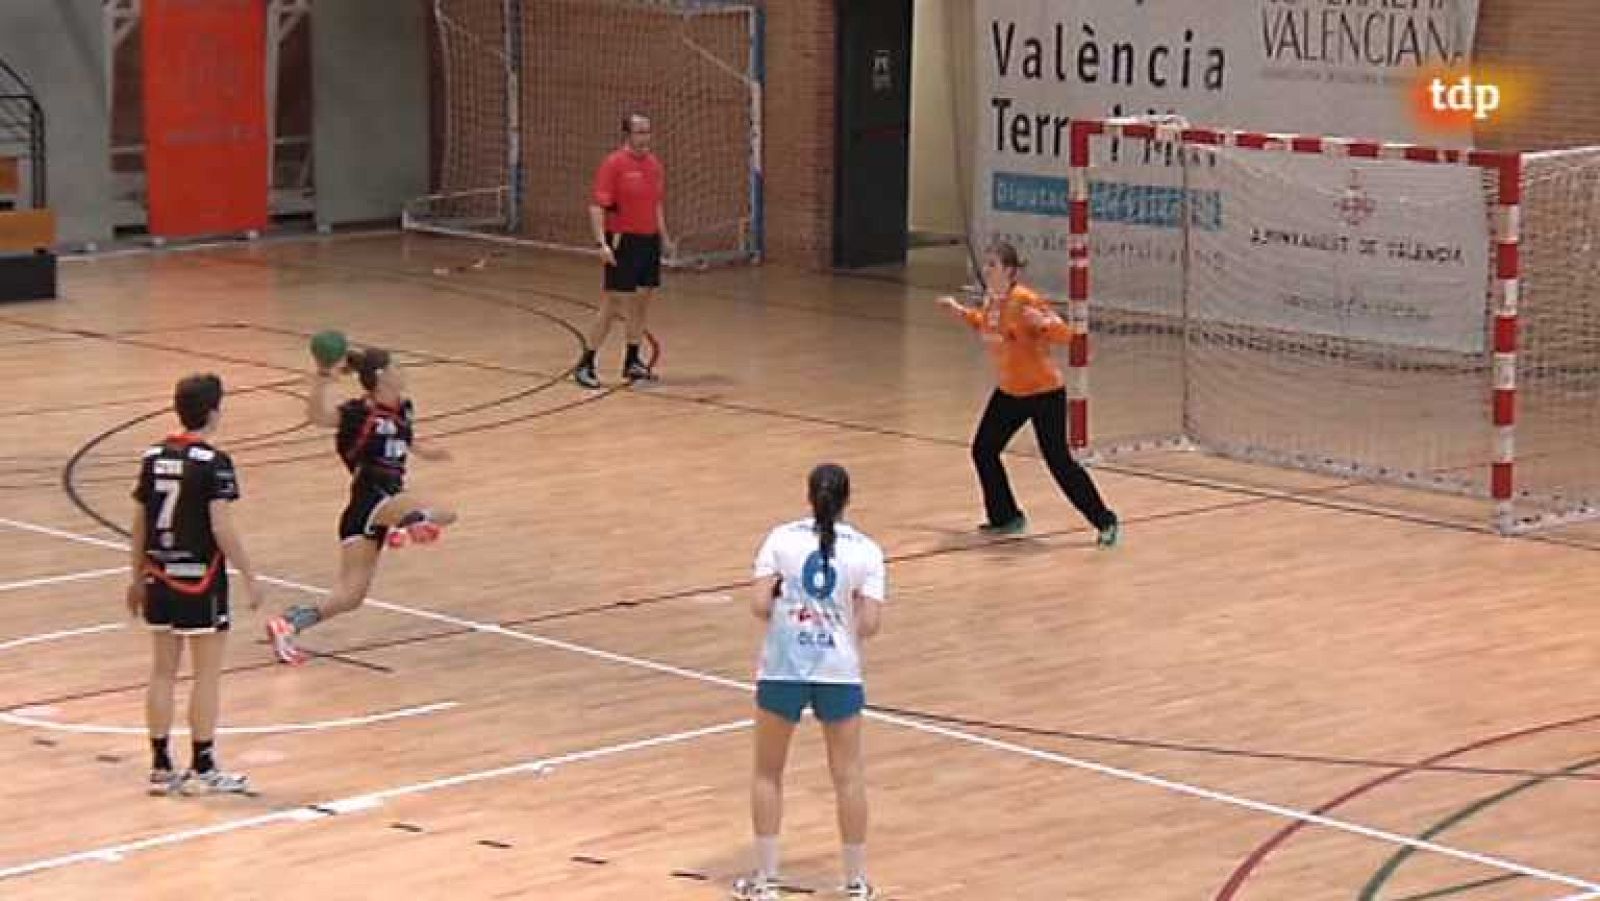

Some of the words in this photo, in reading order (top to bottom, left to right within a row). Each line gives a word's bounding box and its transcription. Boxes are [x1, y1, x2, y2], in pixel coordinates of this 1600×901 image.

[992, 21, 1225, 91] València
[1262, 7, 1466, 68] VALENCIAN
[991, 97, 1071, 157] Terr
[154, 478, 181, 529] 7
[802, 549, 837, 600] 6
